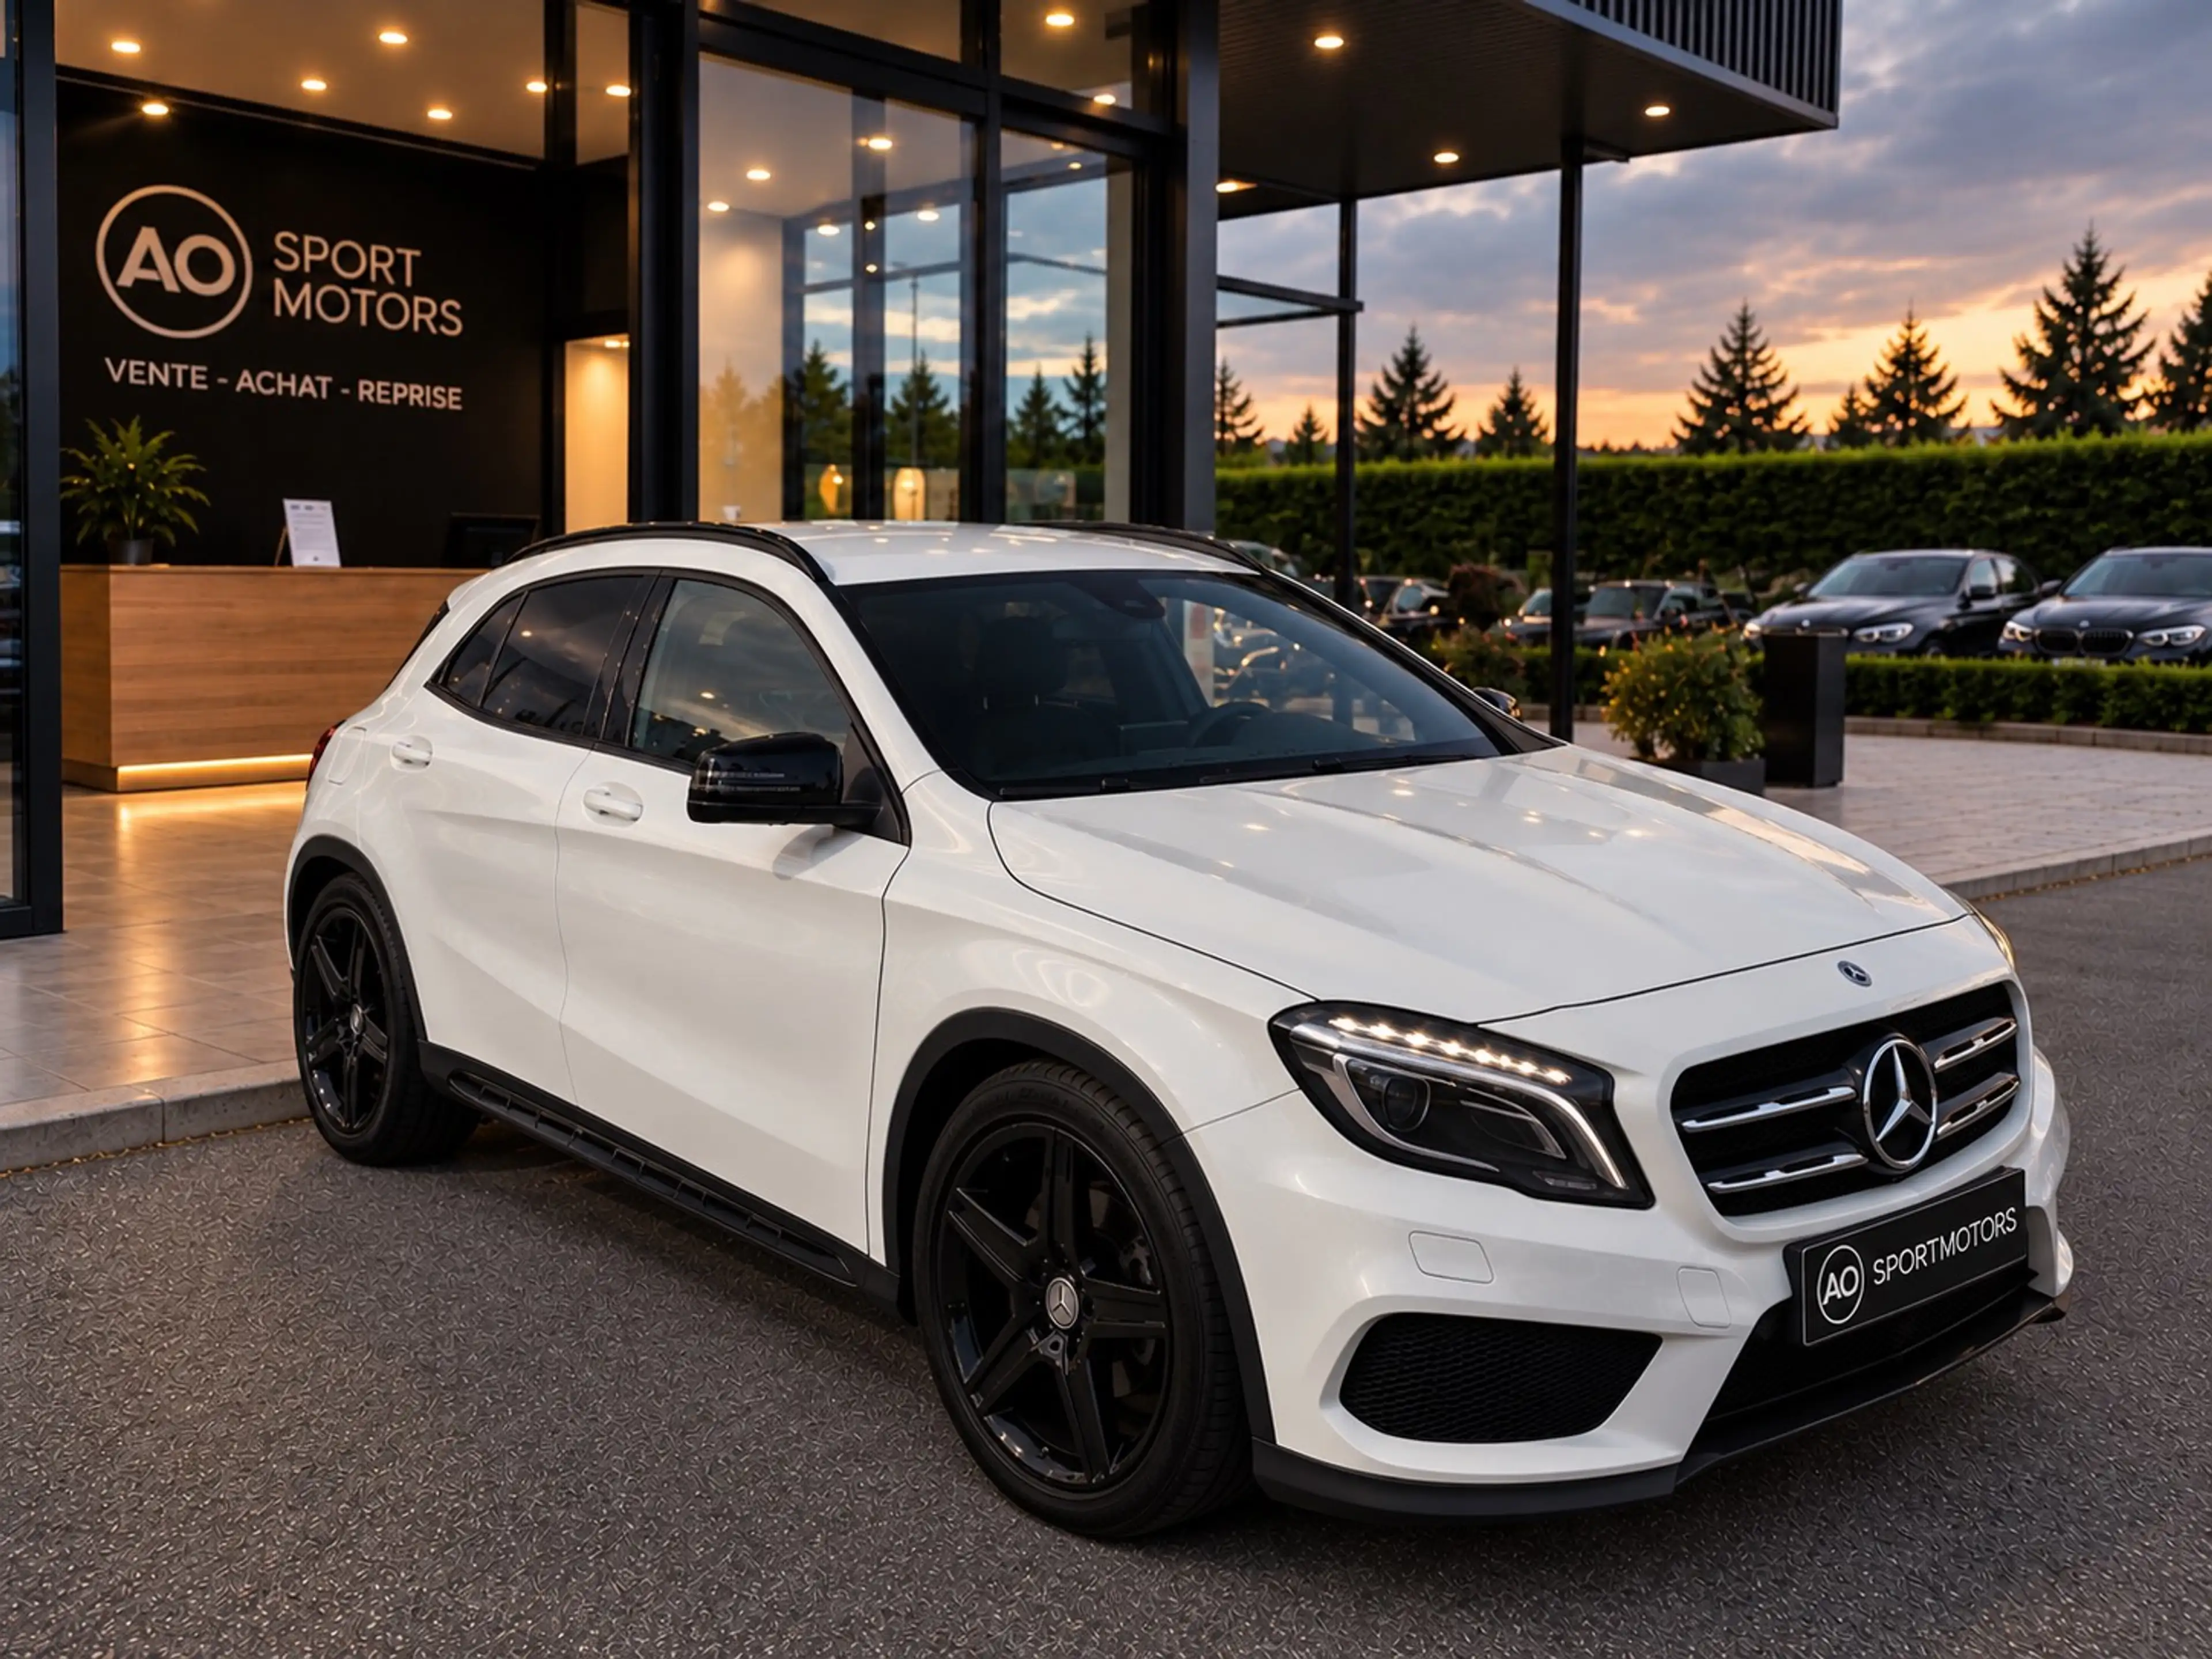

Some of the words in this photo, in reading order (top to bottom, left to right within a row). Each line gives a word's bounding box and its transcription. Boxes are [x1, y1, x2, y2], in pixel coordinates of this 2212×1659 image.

[116, 226, 236, 296] AO
[274, 231, 421, 287] SPORT
[274, 278, 463, 336] MOTORS
[104, 357, 209, 390] VENTE
[235, 369, 333, 399] ACHAT
[358, 379, 463, 410] REPRISE
[1822, 1266, 1859, 1306] AO
[1873, 1206, 2017, 1286] SPORTMOTORS
